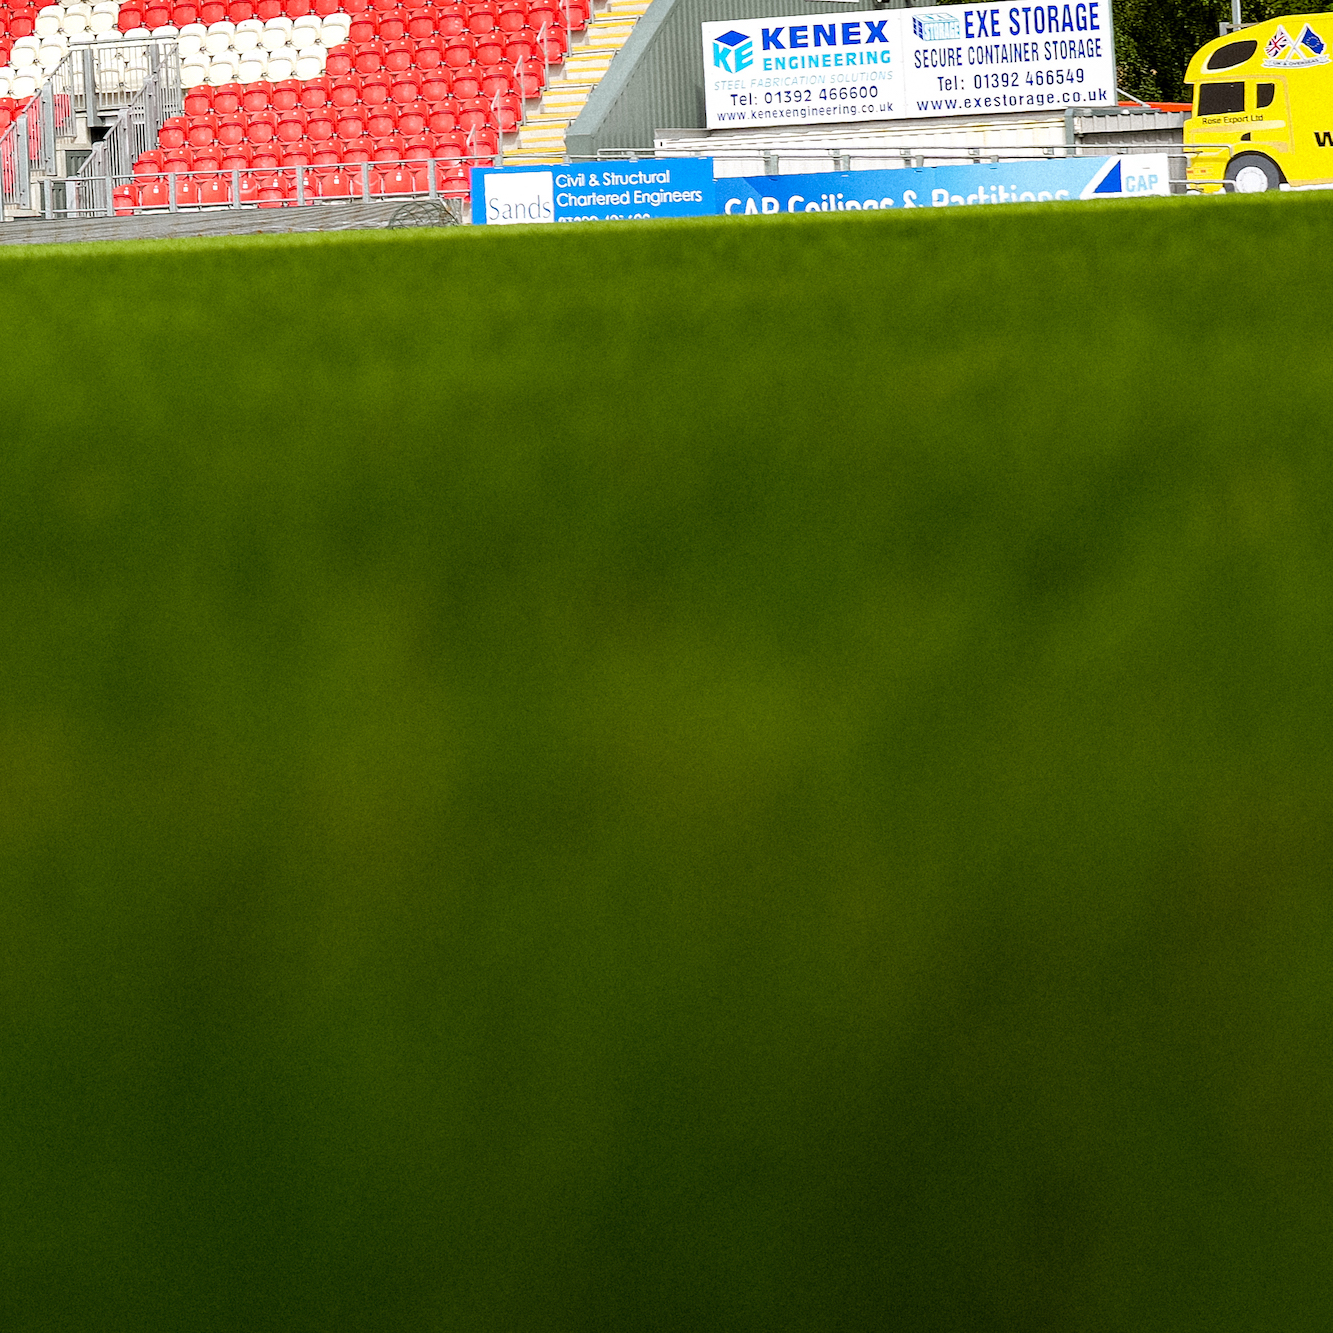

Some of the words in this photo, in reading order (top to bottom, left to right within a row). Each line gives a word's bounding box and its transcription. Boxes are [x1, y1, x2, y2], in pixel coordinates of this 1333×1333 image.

[964, 9, 1001, 39] EXE
[1009, 2, 1100, 36] STORAGE
[761, 20, 890, 51] KENEX
[763, 50, 892, 72] ENGINEERING
[914, 47, 963, 69] SECURE
[968, 42, 1040, 66] CONTAINER
[1044, 38, 1103, 61] STORAGE
[714, 81, 746, 91] STEEL
[750, 75, 826, 89] FABRICATION
[830, 70, 894, 84] SOLUTIONS
[937, 75, 965, 92] Tel:
[974, 72, 1020, 90] 01392
[1025, 68, 1085, 86] 466549
[730, 93, 758, 106] Tel:
[764, 89, 812, 104] 01392
[819, 85, 879, 101] 466600
[916, 88, 1108, 111] www.exestorage.co.uk
[717, 101, 894, 122] www.kenexengineering.co.uk
[1202, 117, 1222, 125] Rose
[1224, 115, 1249, 125] Export
[1250, 114, 1264, 122] Ltd
[555, 173, 584, 188] Civil
[588, 173, 599, 187] &
[602, 169, 671, 185] Structural
[1125, 174, 1159, 193] CAP
[488, 194, 552, 221] Sands
[556, 191, 631, 208] Chartered
[633, 189, 703, 207] Engineers
